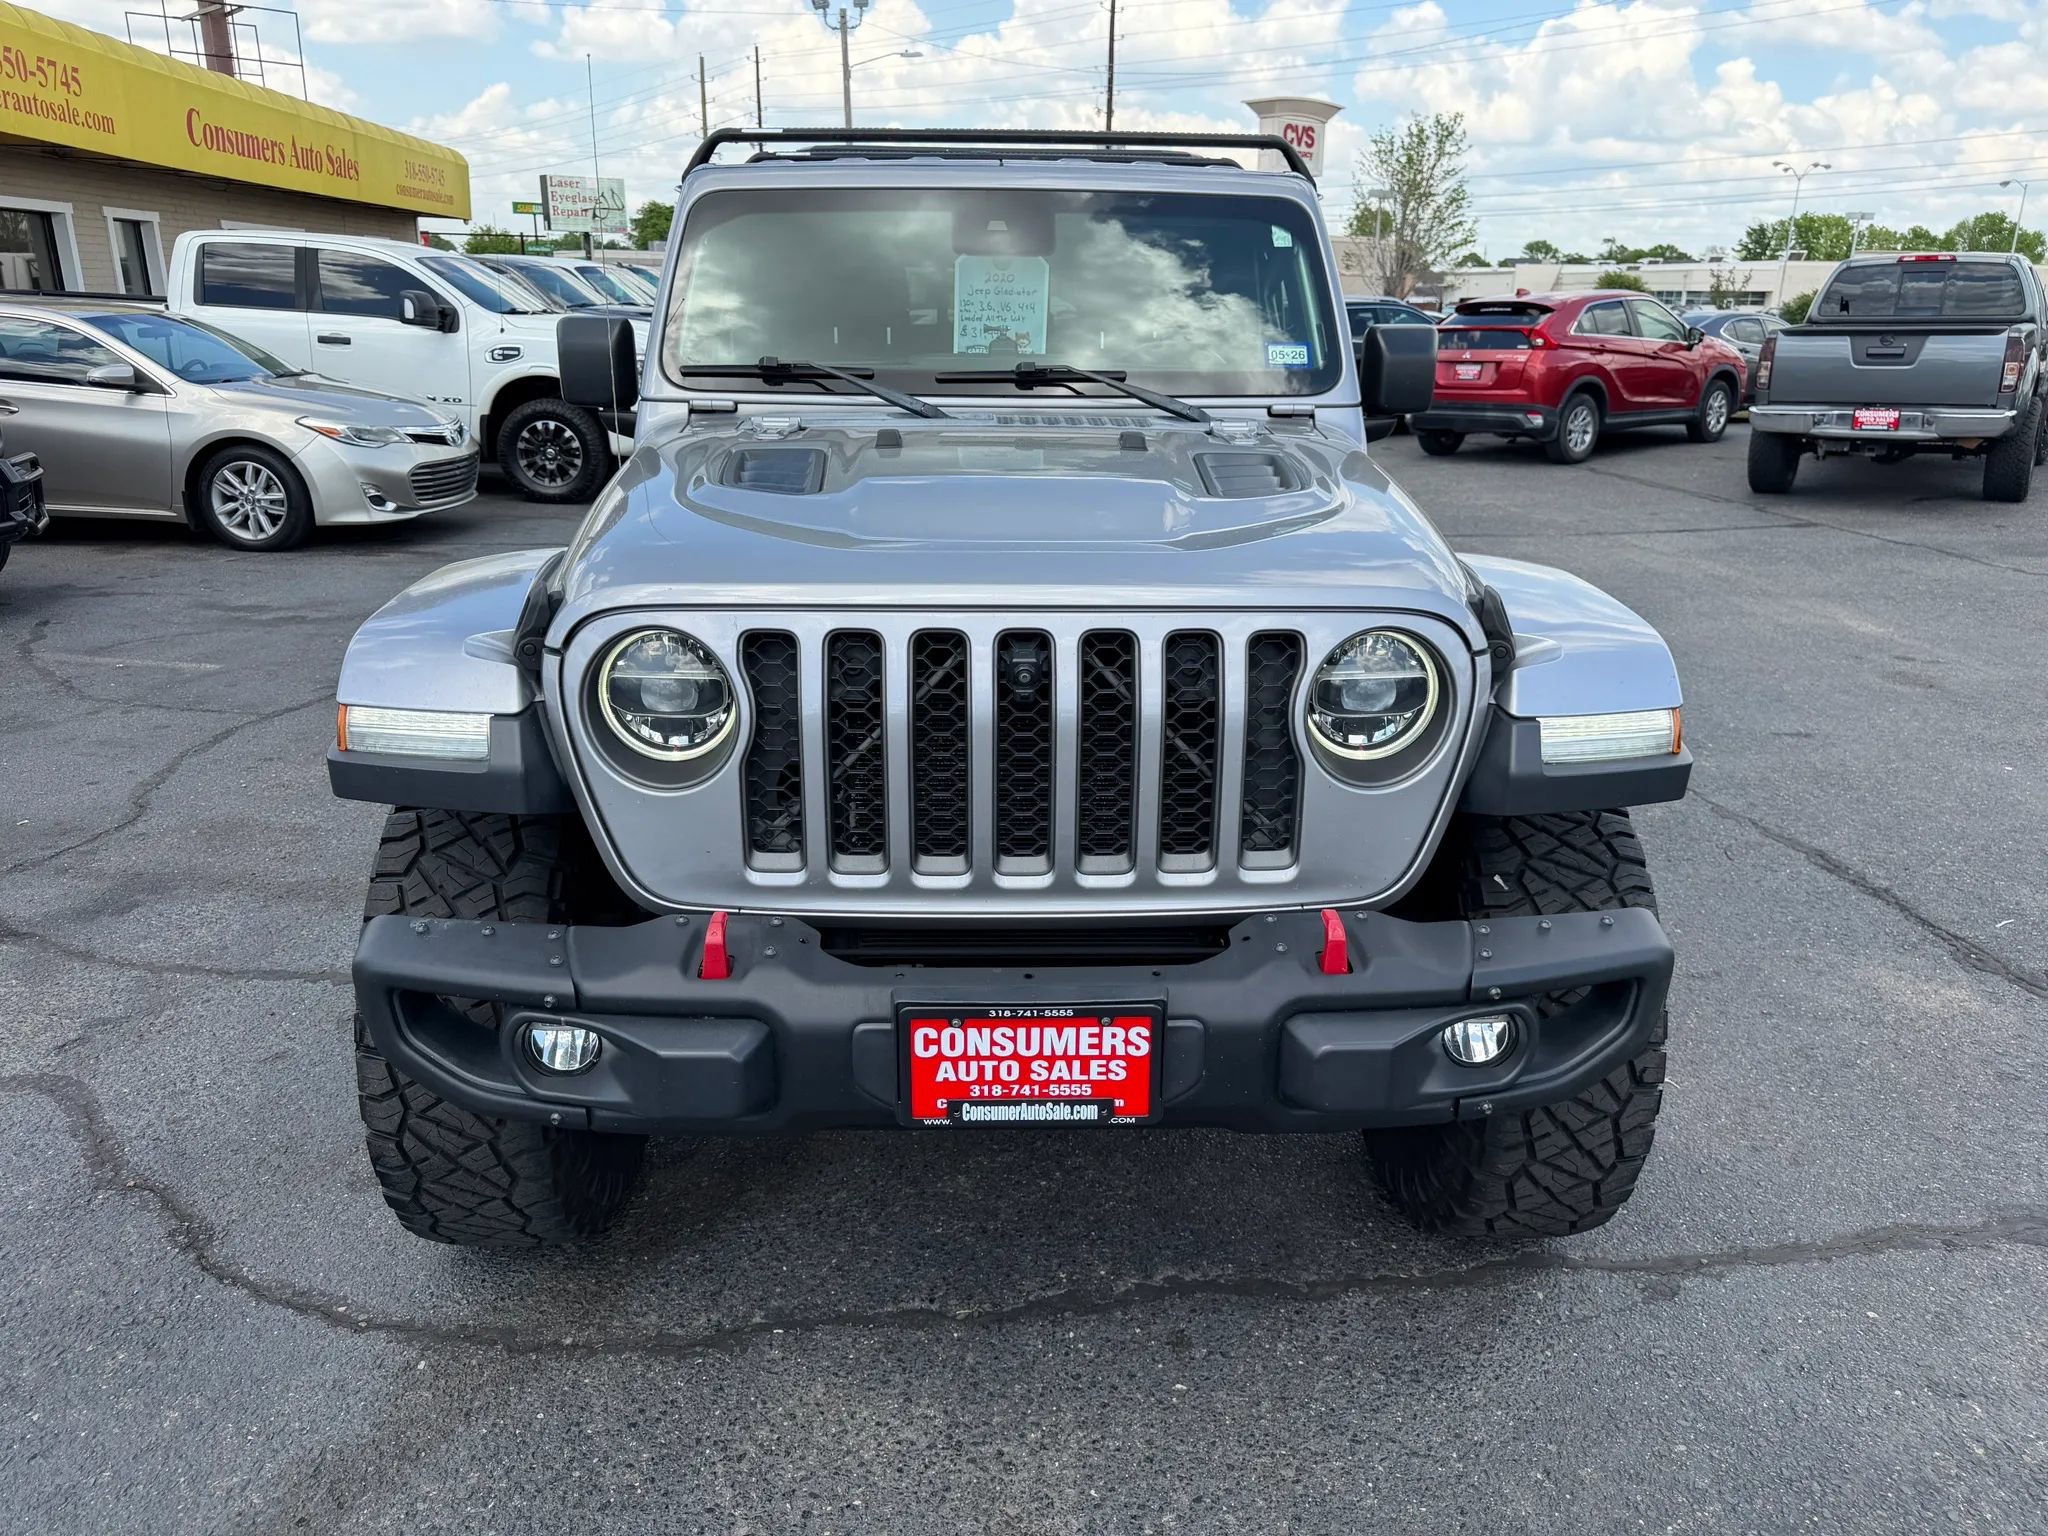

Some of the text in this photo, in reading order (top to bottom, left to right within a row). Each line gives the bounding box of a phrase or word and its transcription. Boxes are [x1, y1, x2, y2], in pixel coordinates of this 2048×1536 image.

[0, 45, 82, 97] 50-5745
[1283, 123, 1315, 149] CVS
[186, 107, 360, 181] Consumers Auto Sales
[549, 175, 580, 189] Laser
[552, 205, 588, 219] Repair
[984, 272, 1015, 283] 2020
[968, 284, 991, 299] Jeep
[989, 1009, 1074, 1017] 318-741-5555
[914, 1026, 1151, 1058] CONSUMERS
[935, 1059, 1127, 1082] AUTO SALES
[969, 1084, 1092, 1097] 318-741-5555
[961, 1102, 1098, 1122] ConsumerAutoSale.com
[1108, 1116, 1136, 1124] .COM
